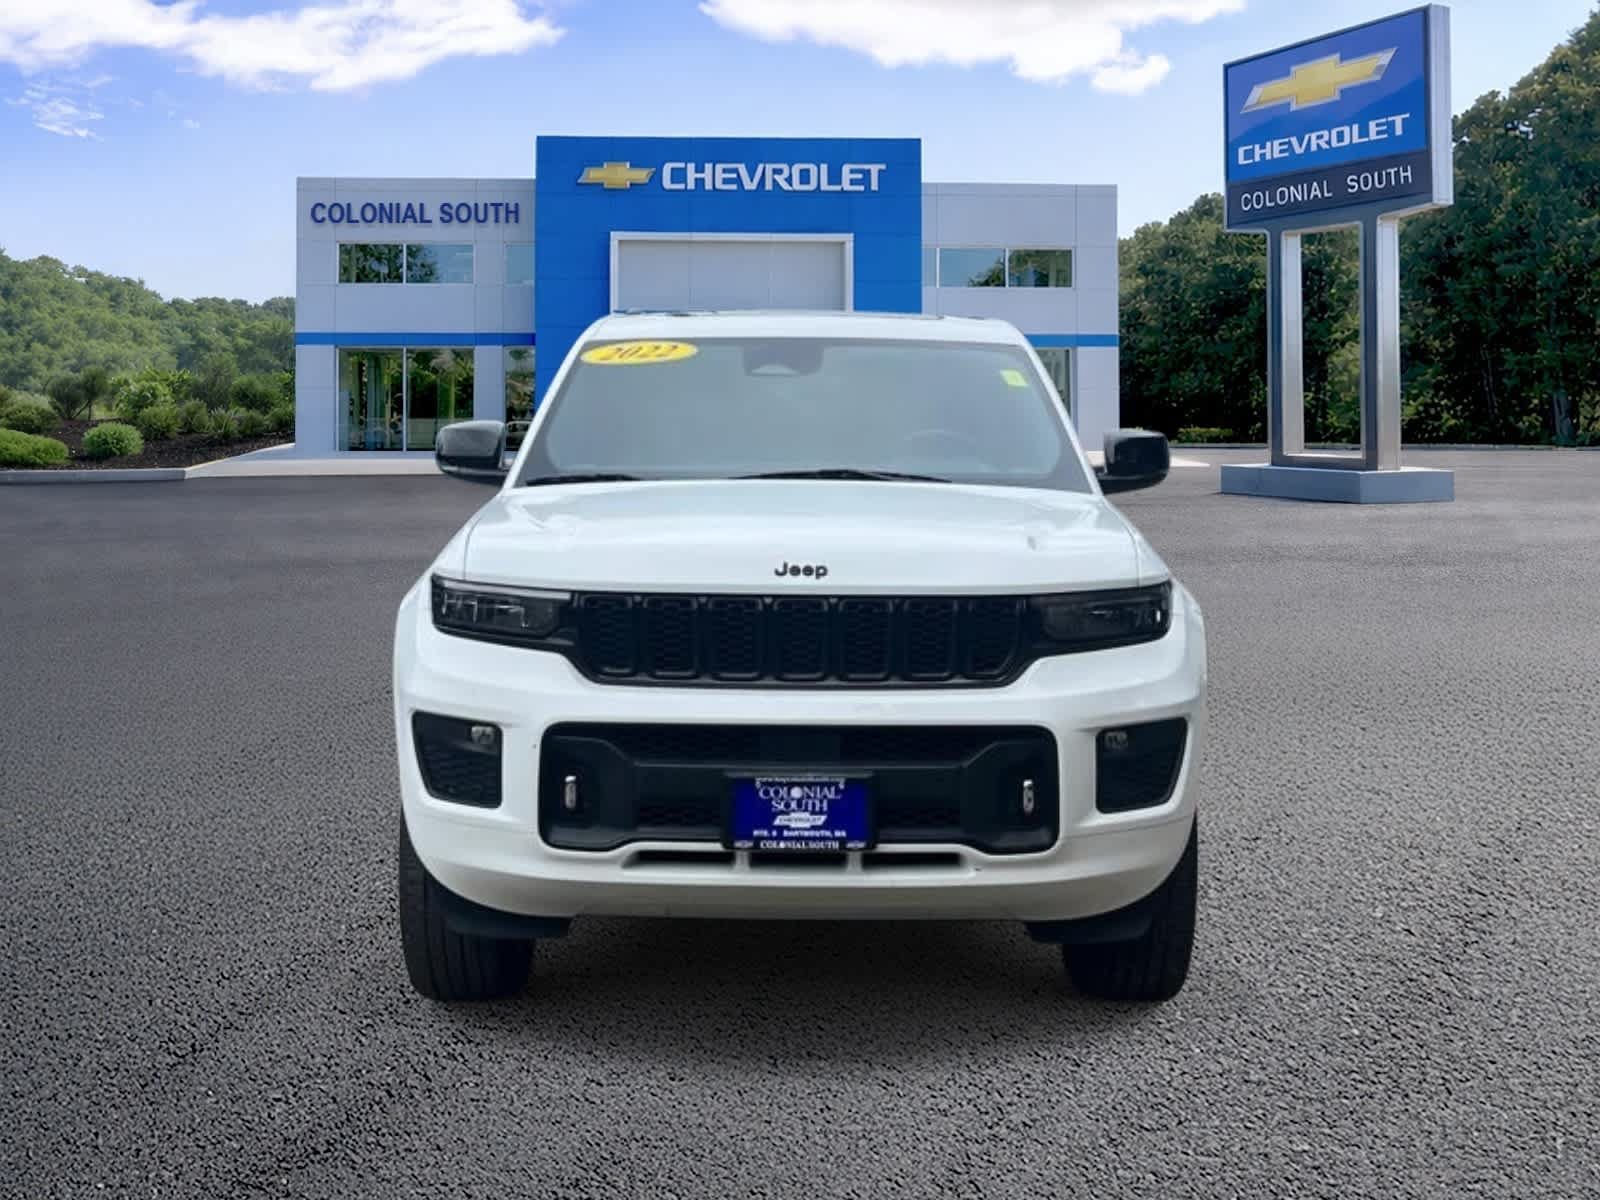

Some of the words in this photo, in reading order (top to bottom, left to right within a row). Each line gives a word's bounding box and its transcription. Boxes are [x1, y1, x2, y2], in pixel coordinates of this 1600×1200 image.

[1237, 113, 1410, 165] CHEVROLET
[662, 162, 887, 192] CHEVROLET
[1241, 180, 1333, 211] COLONIAL
[1346, 165, 1413, 193] SOUTH
[310, 202, 433, 224] COLONIAL
[439, 202, 520, 224] SOUTH
[599, 344, 680, 361] 2022
[774, 562, 828, 580] Jeep
[758, 786, 840, 799] COLONIAL
[771, 799, 828, 812] SOUTH
